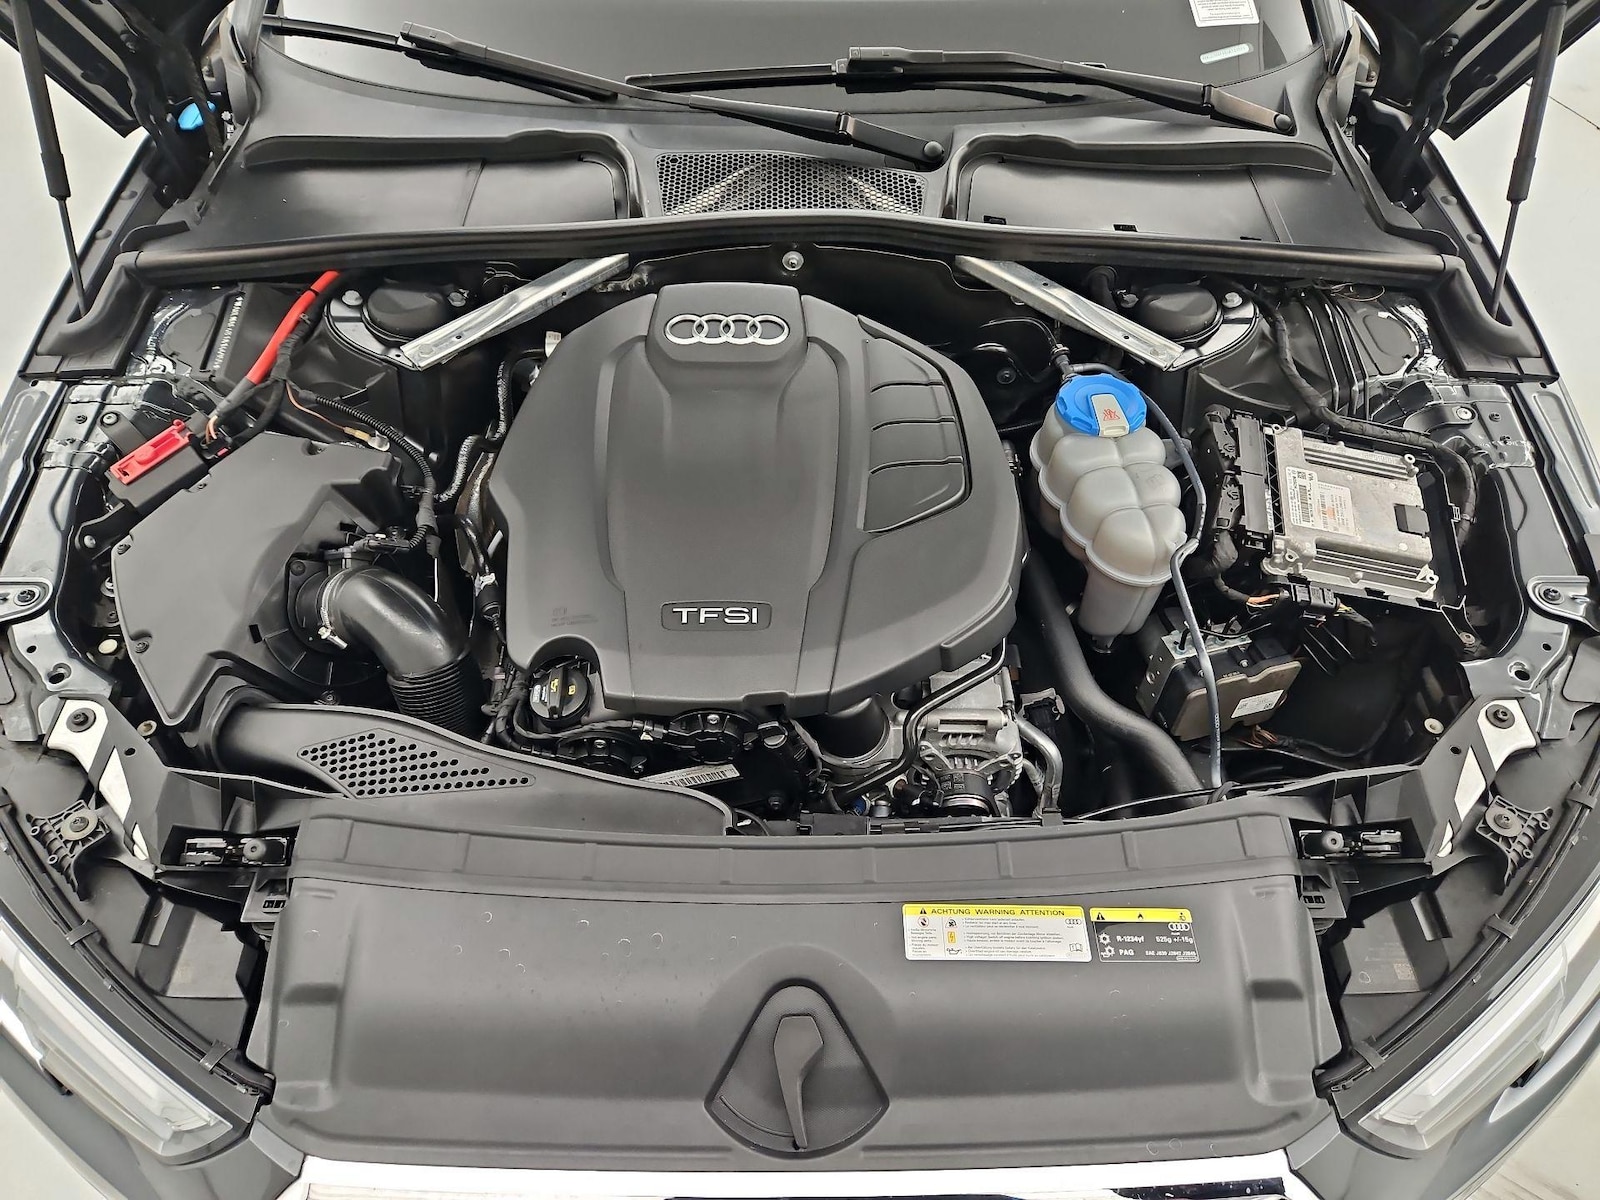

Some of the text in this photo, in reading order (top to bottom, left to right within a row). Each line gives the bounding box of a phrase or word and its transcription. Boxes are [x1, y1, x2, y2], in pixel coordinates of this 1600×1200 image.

[672, 607, 758, 624] TFSI
[1116, 935, 1145, 943] R-1234yf
[1155, 936, 1172, 944] 525g
